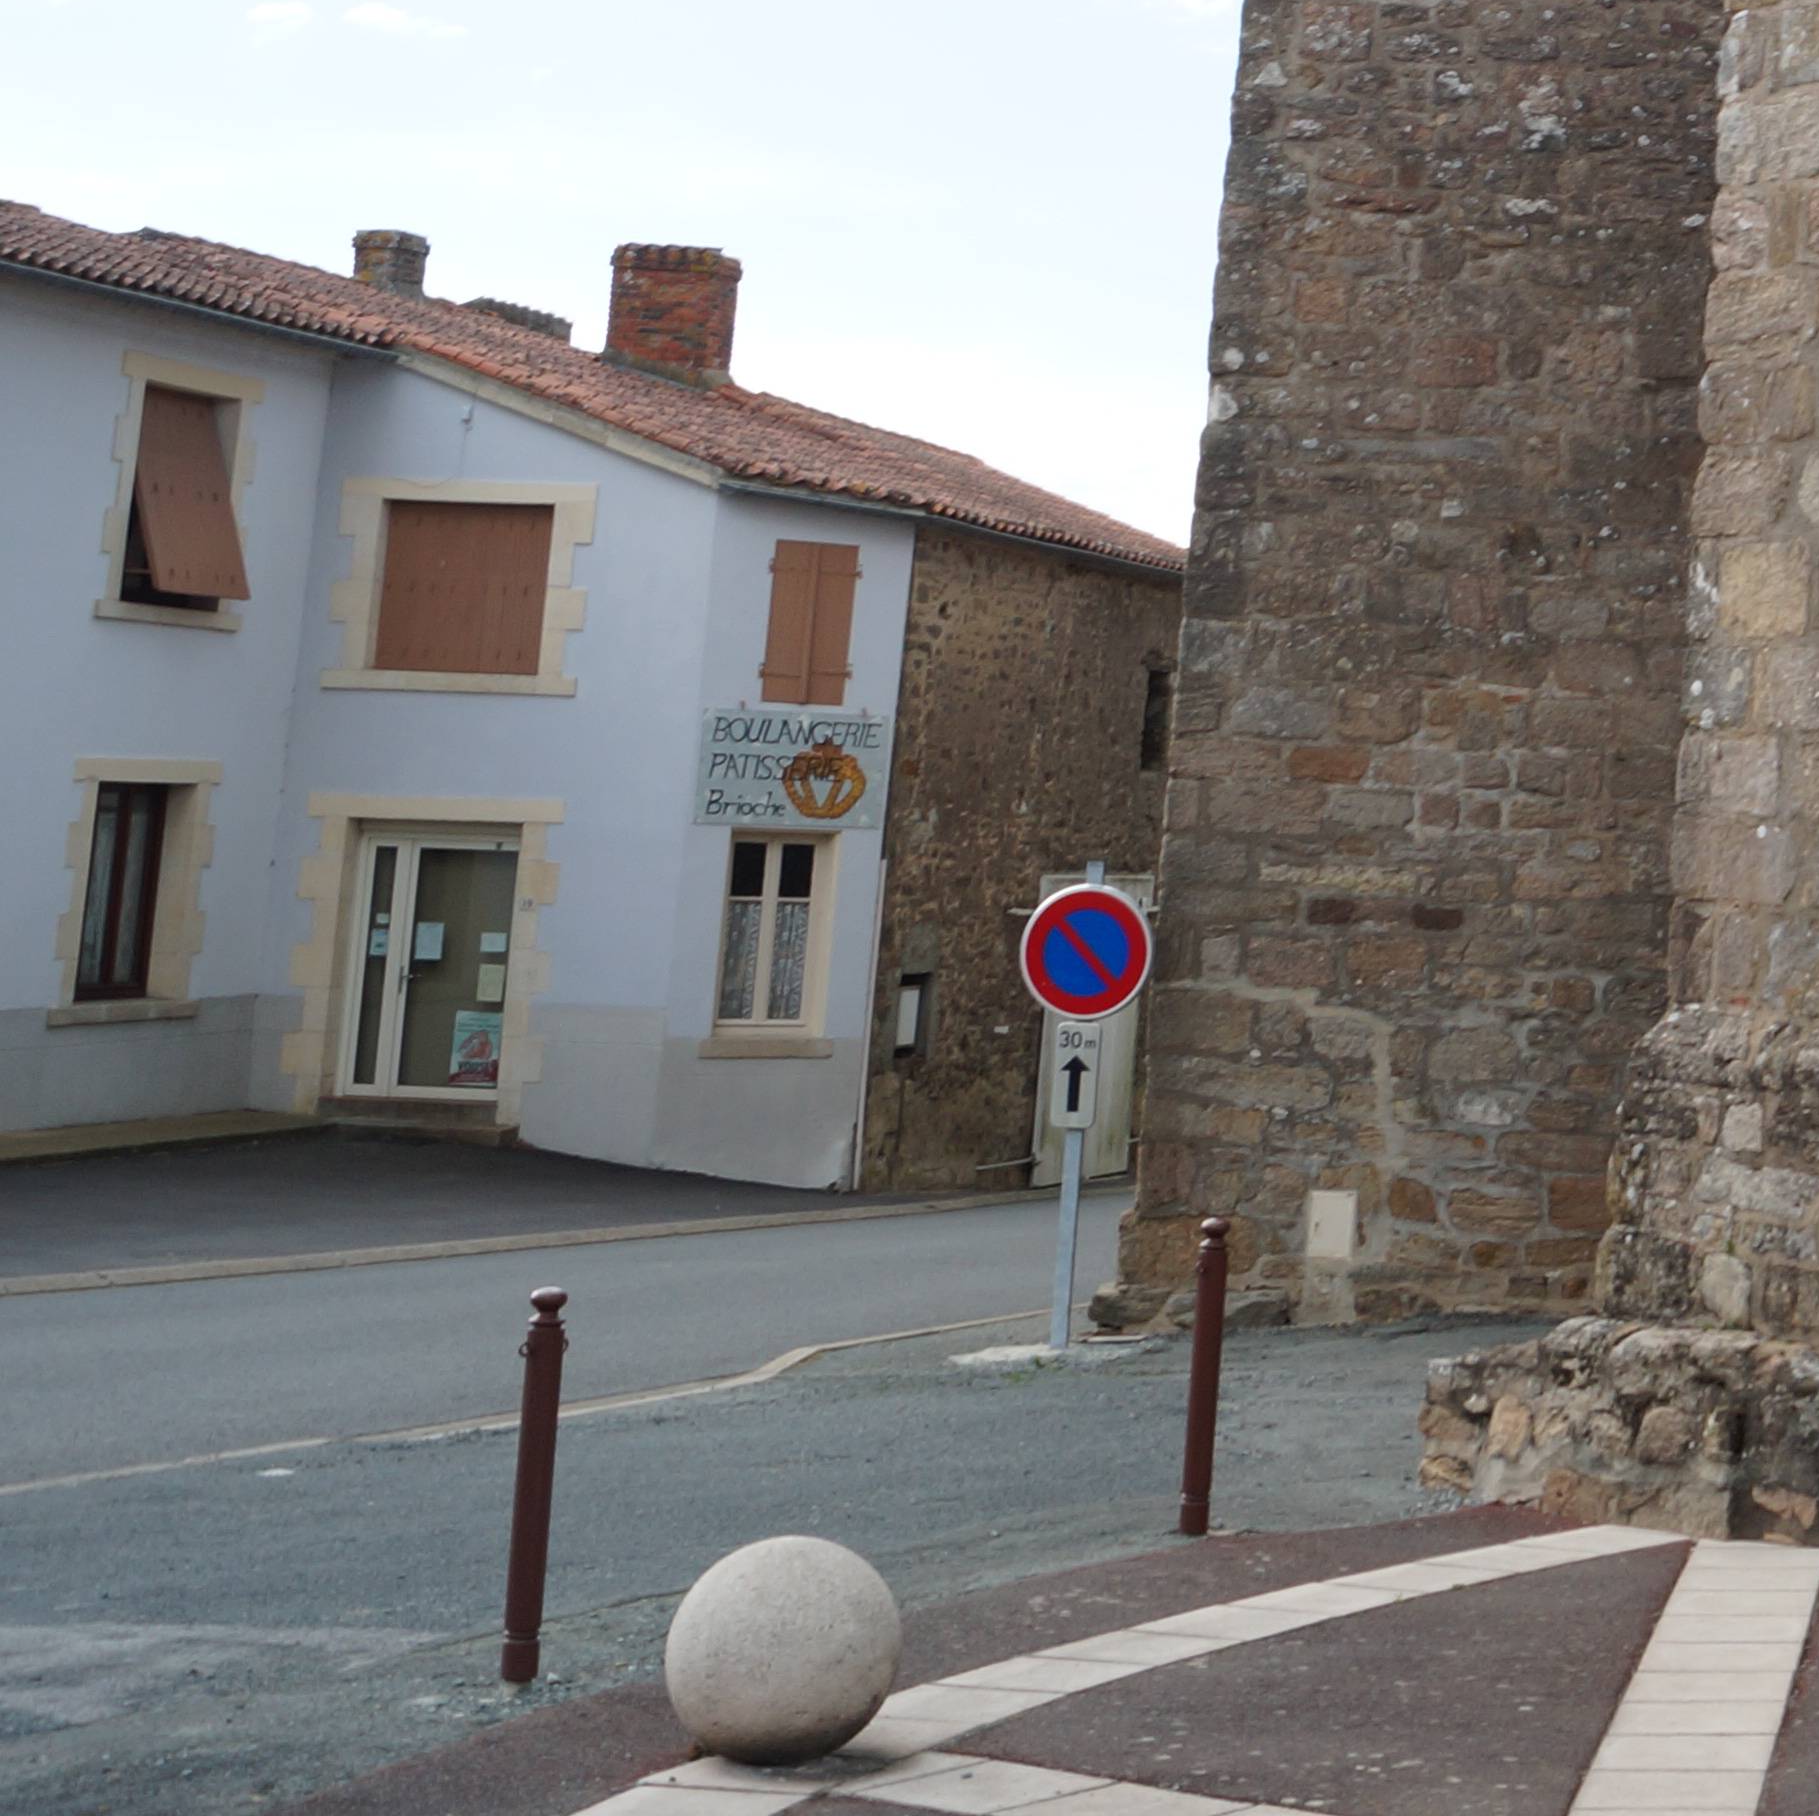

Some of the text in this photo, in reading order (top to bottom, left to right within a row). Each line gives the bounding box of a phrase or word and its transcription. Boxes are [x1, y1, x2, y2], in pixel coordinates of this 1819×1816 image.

[712, 716, 882, 748] BOULANGERIE
[707, 753, 841, 783] PATISSERIE
[705, 789, 786, 817] Brioche
